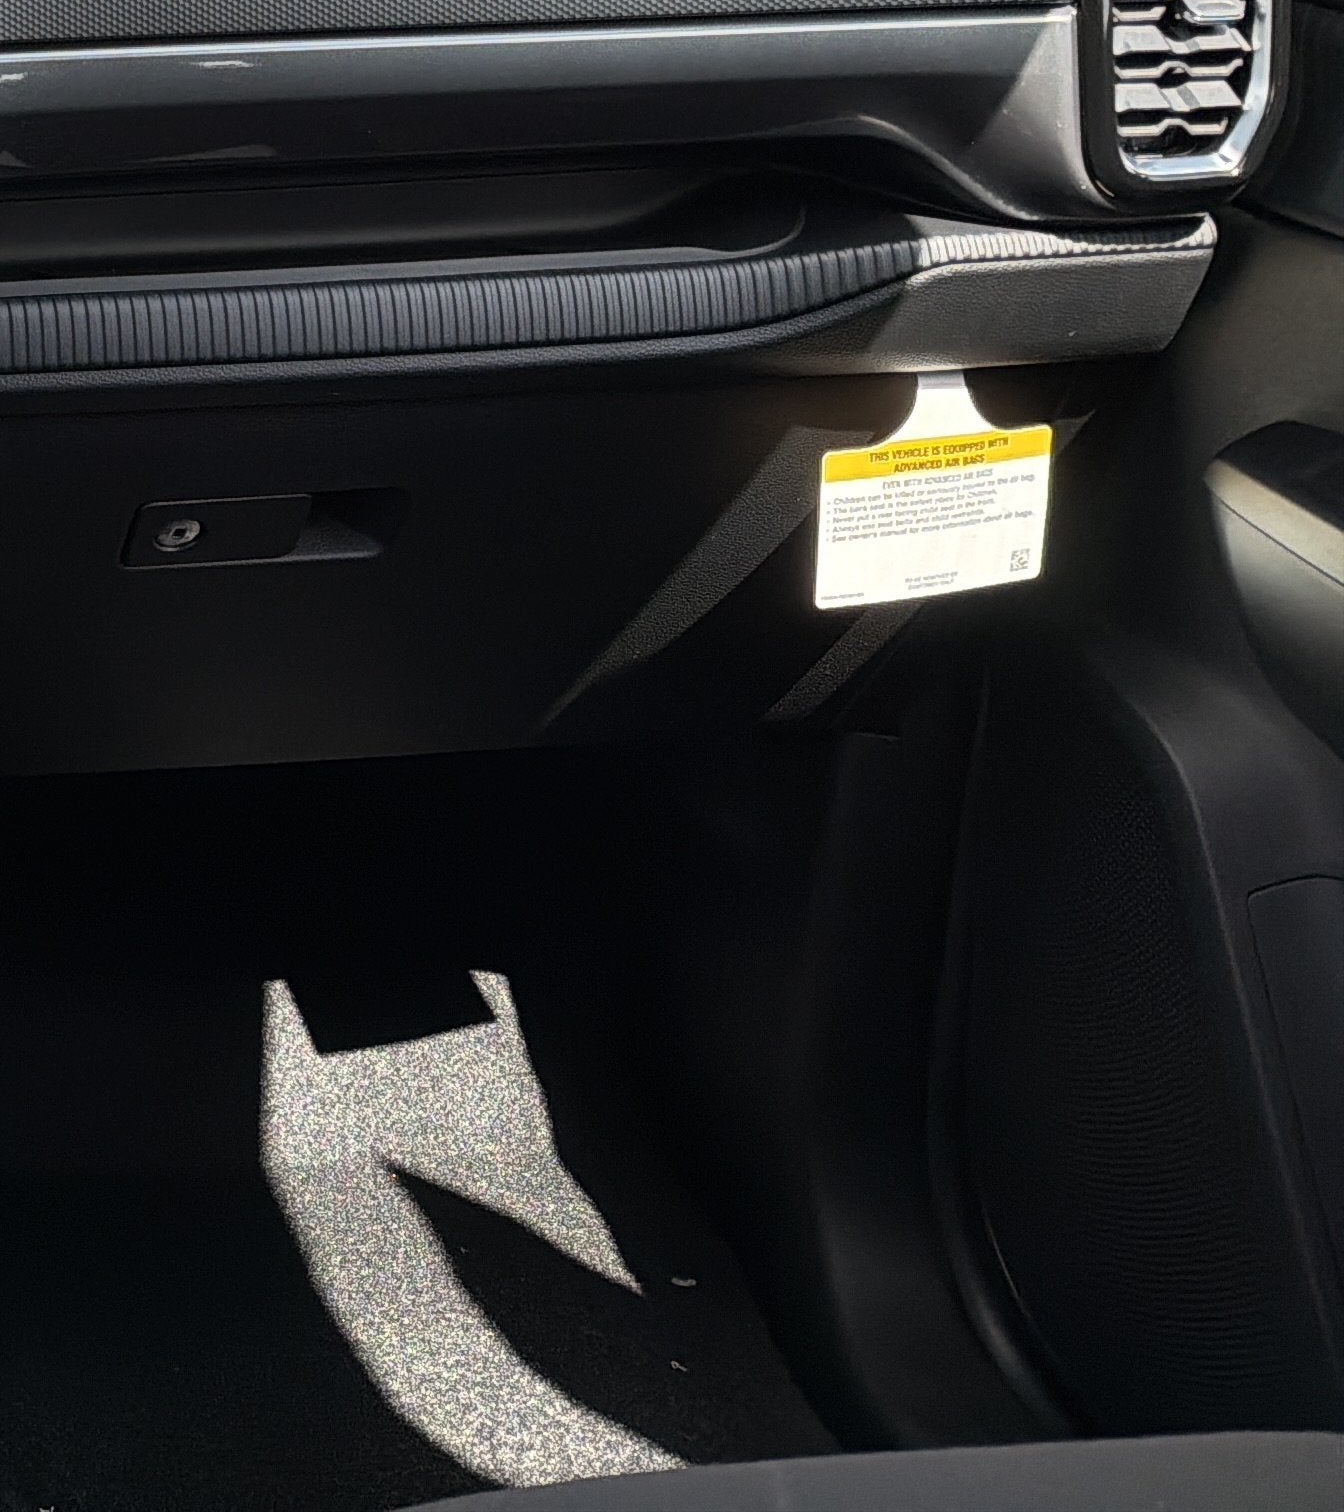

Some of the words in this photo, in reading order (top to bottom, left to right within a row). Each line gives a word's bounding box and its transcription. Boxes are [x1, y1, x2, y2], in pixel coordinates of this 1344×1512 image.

[869, 451, 889, 462] THIS
[891, 446, 930, 459] VEHICLE
[931, 445, 941, 455] IS
[943, 440, 986, 454] EQUIPPED
[987, 436, 1009, 448] WITH
[894, 459, 943, 472] ADVANCED
[945, 457, 960, 467] AIR
[962, 453, 985, 466] BAGS
